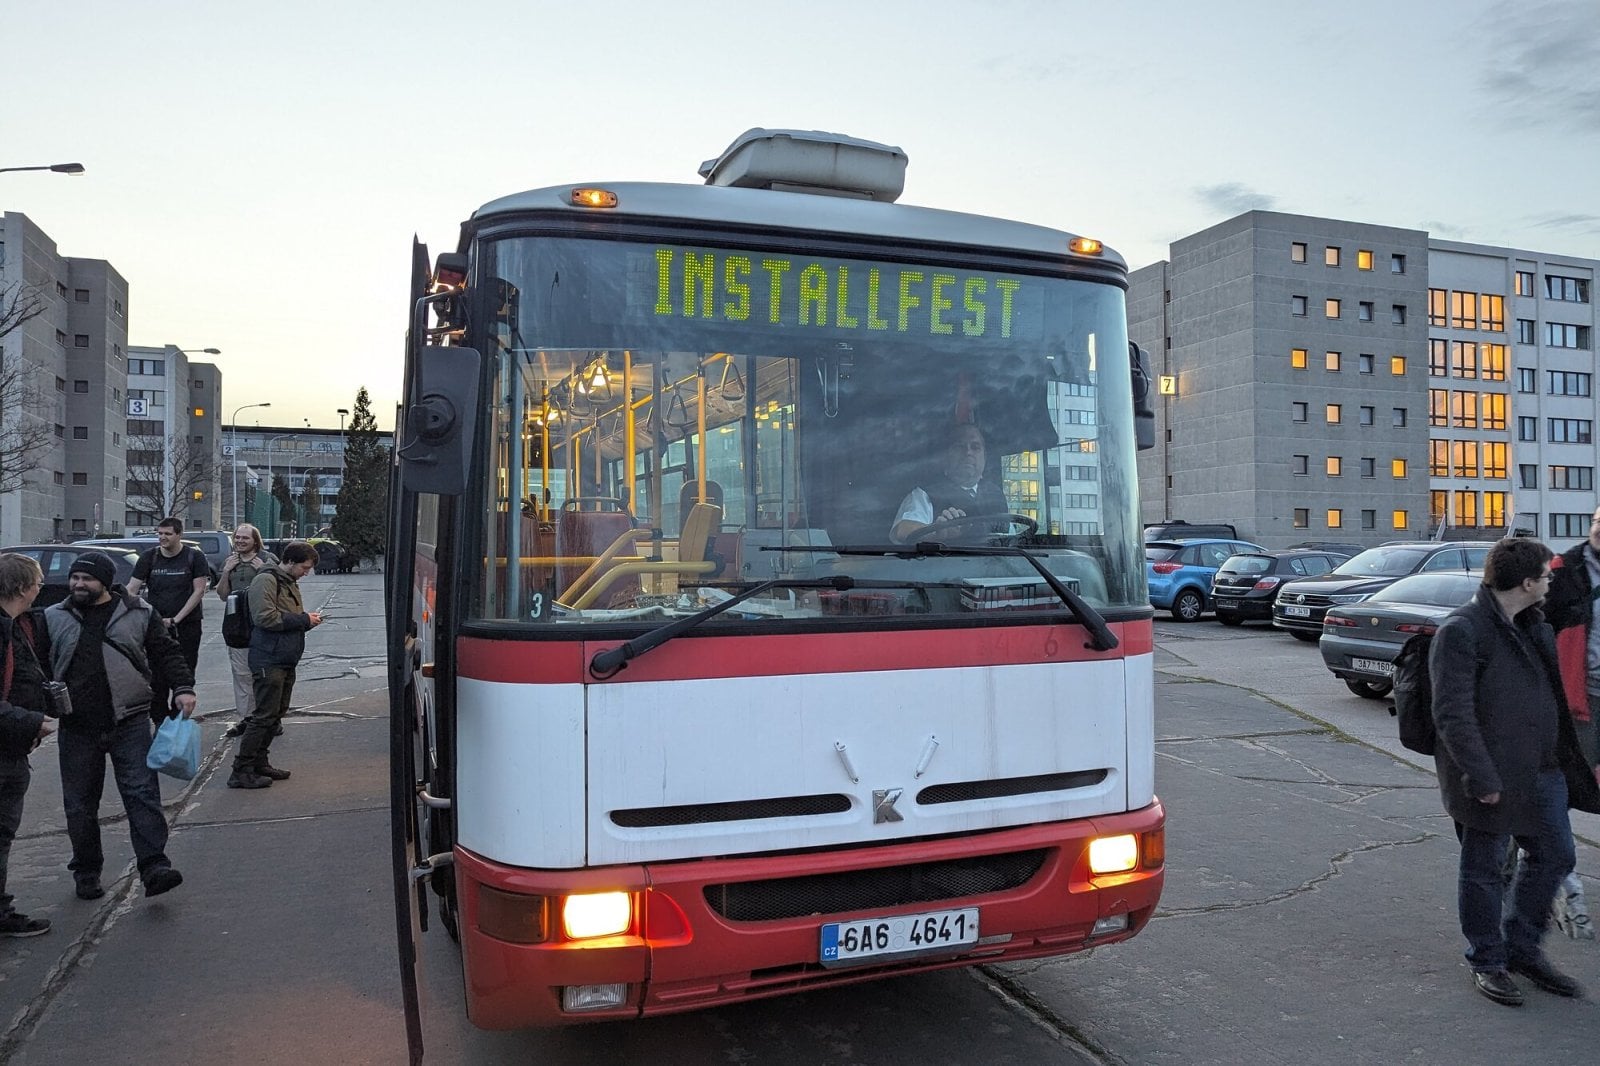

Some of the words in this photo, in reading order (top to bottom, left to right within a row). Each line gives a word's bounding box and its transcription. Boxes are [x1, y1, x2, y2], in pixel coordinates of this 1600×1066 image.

[654, 248, 1021, 339] INSTALLFEST
[1163, 378, 1171, 392] 7
[133, 401, 143, 413] 3
[225, 446, 232, 455] 2
[530, 592, 543, 618] 3
[1358, 659, 1371, 668] 3A7
[1377, 661, 1395, 672] 1602
[844, 923, 890, 952] 6A6
[909, 914, 965, 946] 4641
[824, 946, 837, 956] CZ
